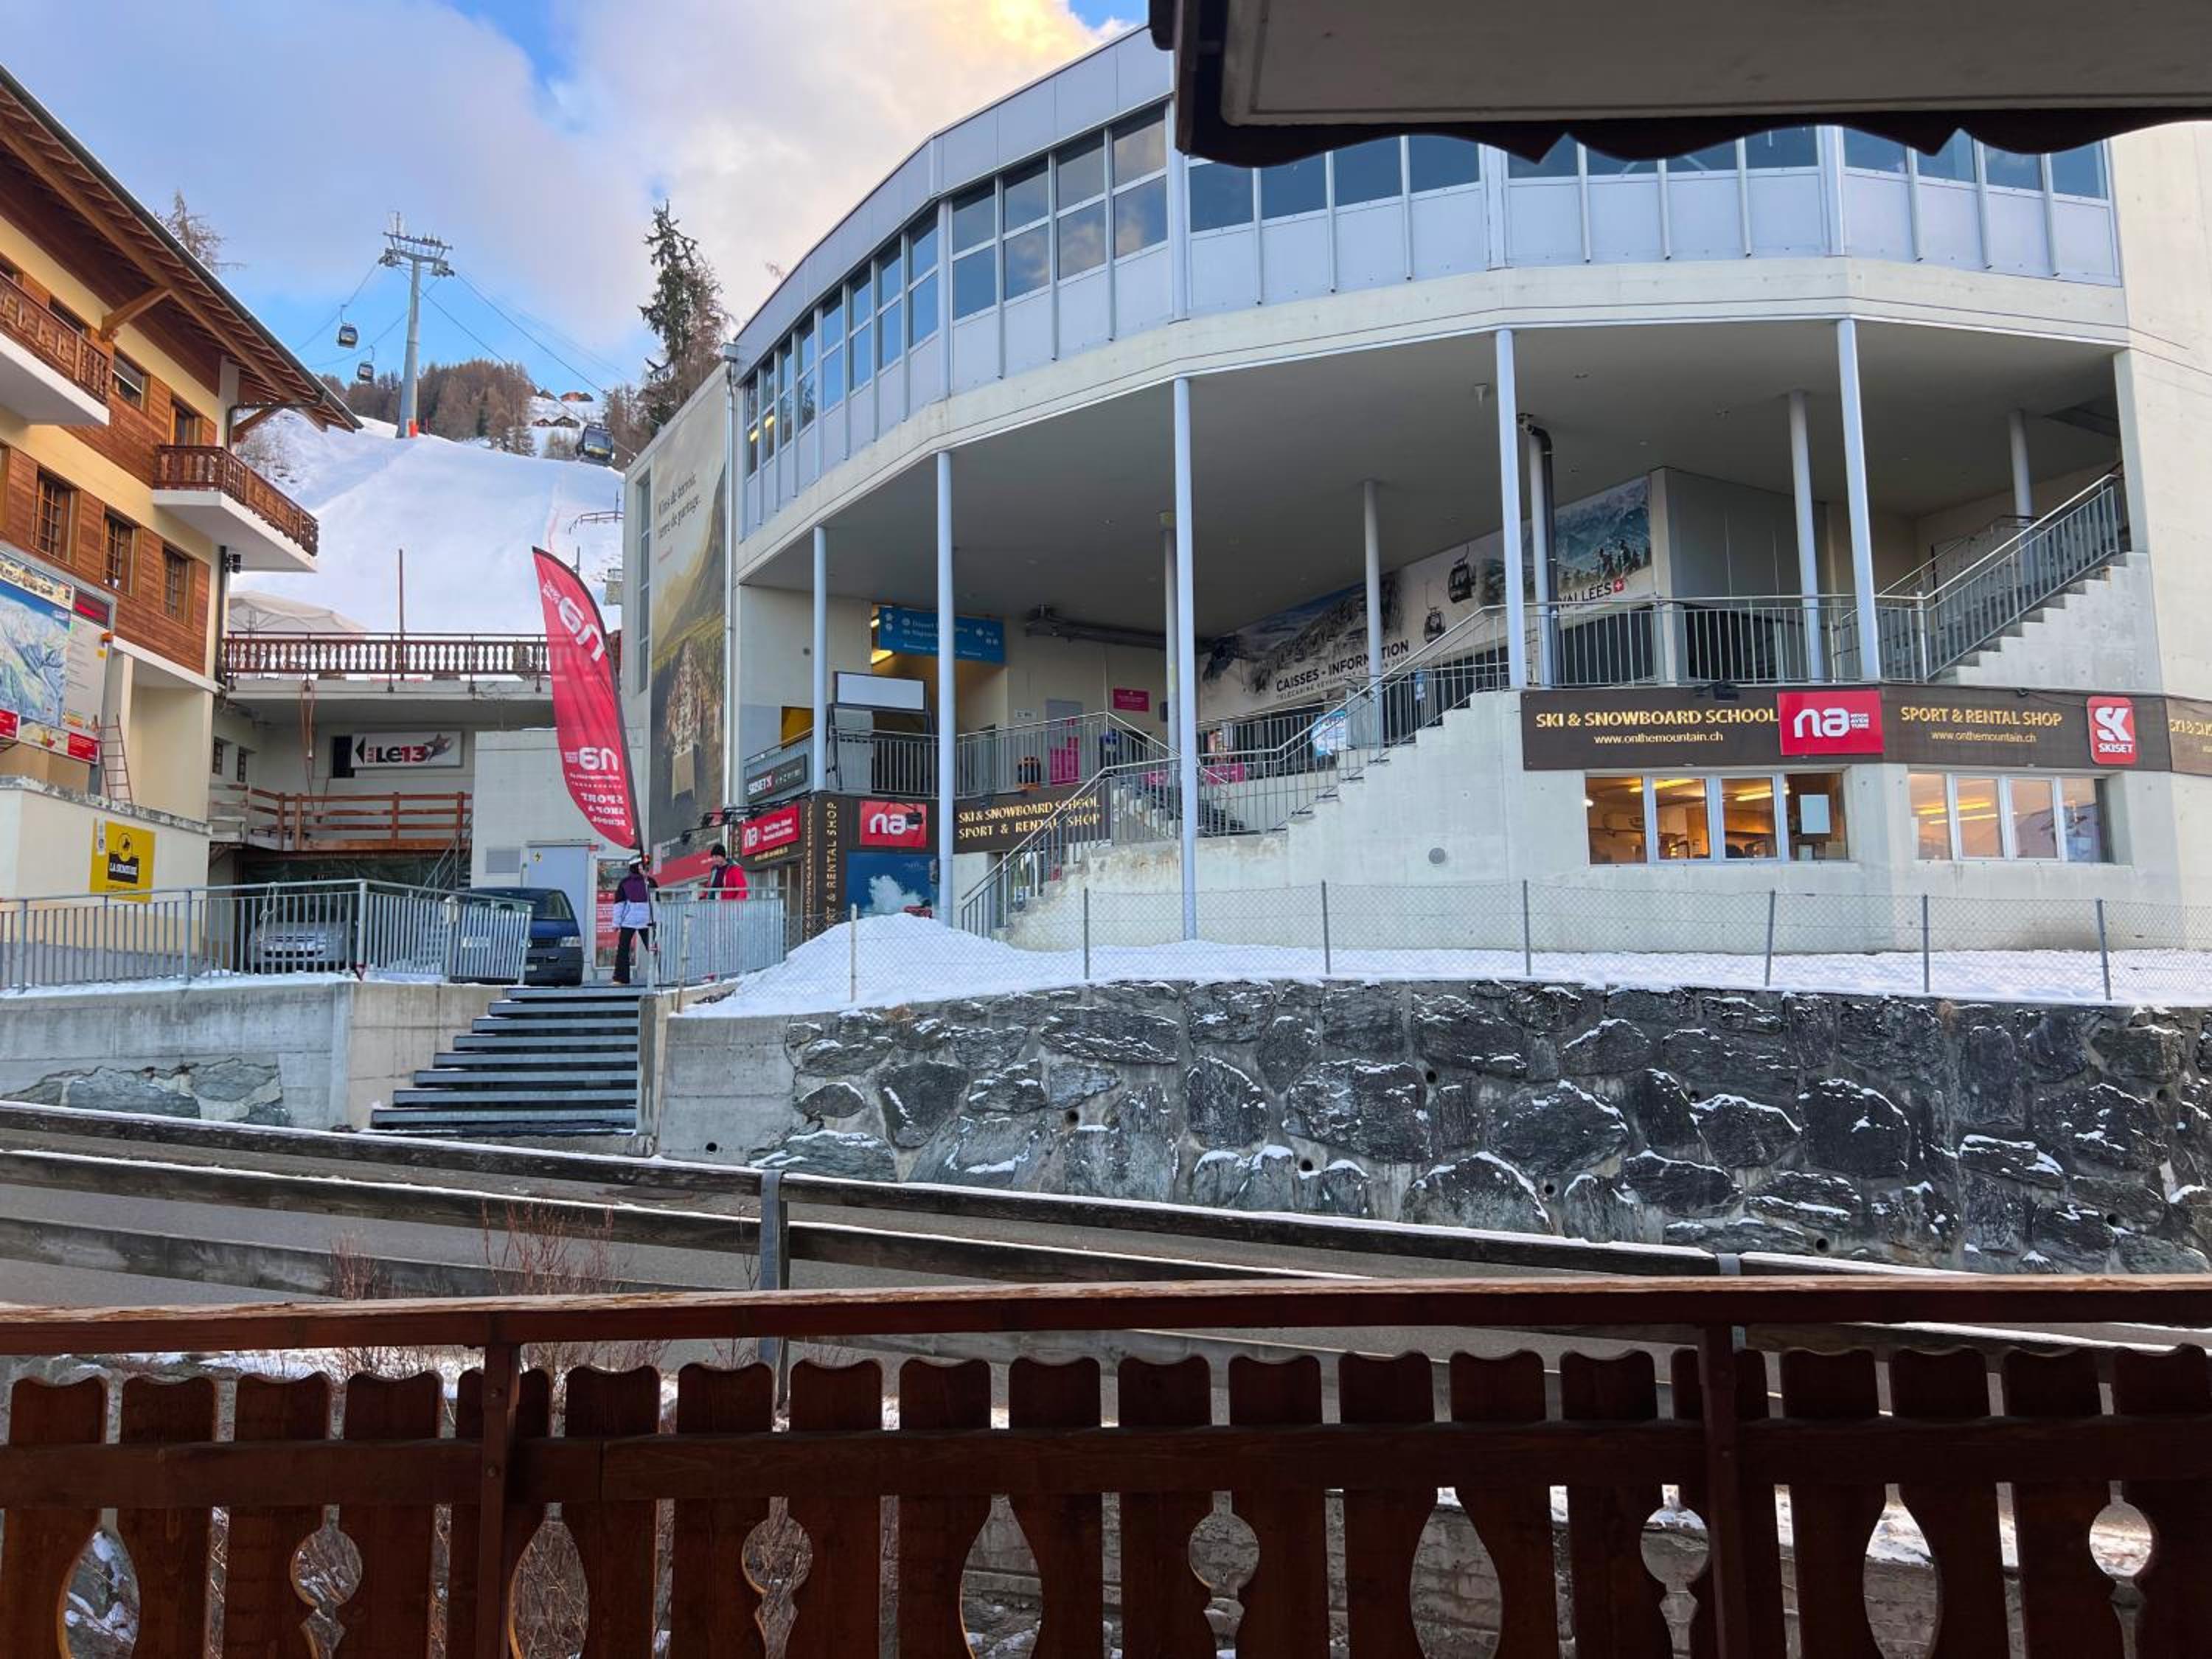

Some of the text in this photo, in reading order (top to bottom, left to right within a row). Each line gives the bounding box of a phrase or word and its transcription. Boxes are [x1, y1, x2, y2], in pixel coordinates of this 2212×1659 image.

[1276, 668, 1319, 692] CAISSES
[1536, 708, 1780, 727] SKI & SNOWBOARD SCHOOL
[1794, 707, 1850, 738] na
[1900, 706, 2062, 726] SPORT & RENTAL SHOP
[1594, 731, 1723, 743] www.onthemountain.ch
[1932, 731, 2037, 742] www.onthemountain.ch
[2098, 742, 2133, 753] SKISET
[827, 801, 838, 836] SHOP
[959, 796, 1101, 823] SKI & SNOWBOARD SCHOOL
[959, 825, 992, 838] SPORT
[1001, 824, 1009, 834] &
[1067, 813, 1101, 827] SHOP
[827, 841, 837, 892] RENTAL
[827, 894, 837, 902] &
